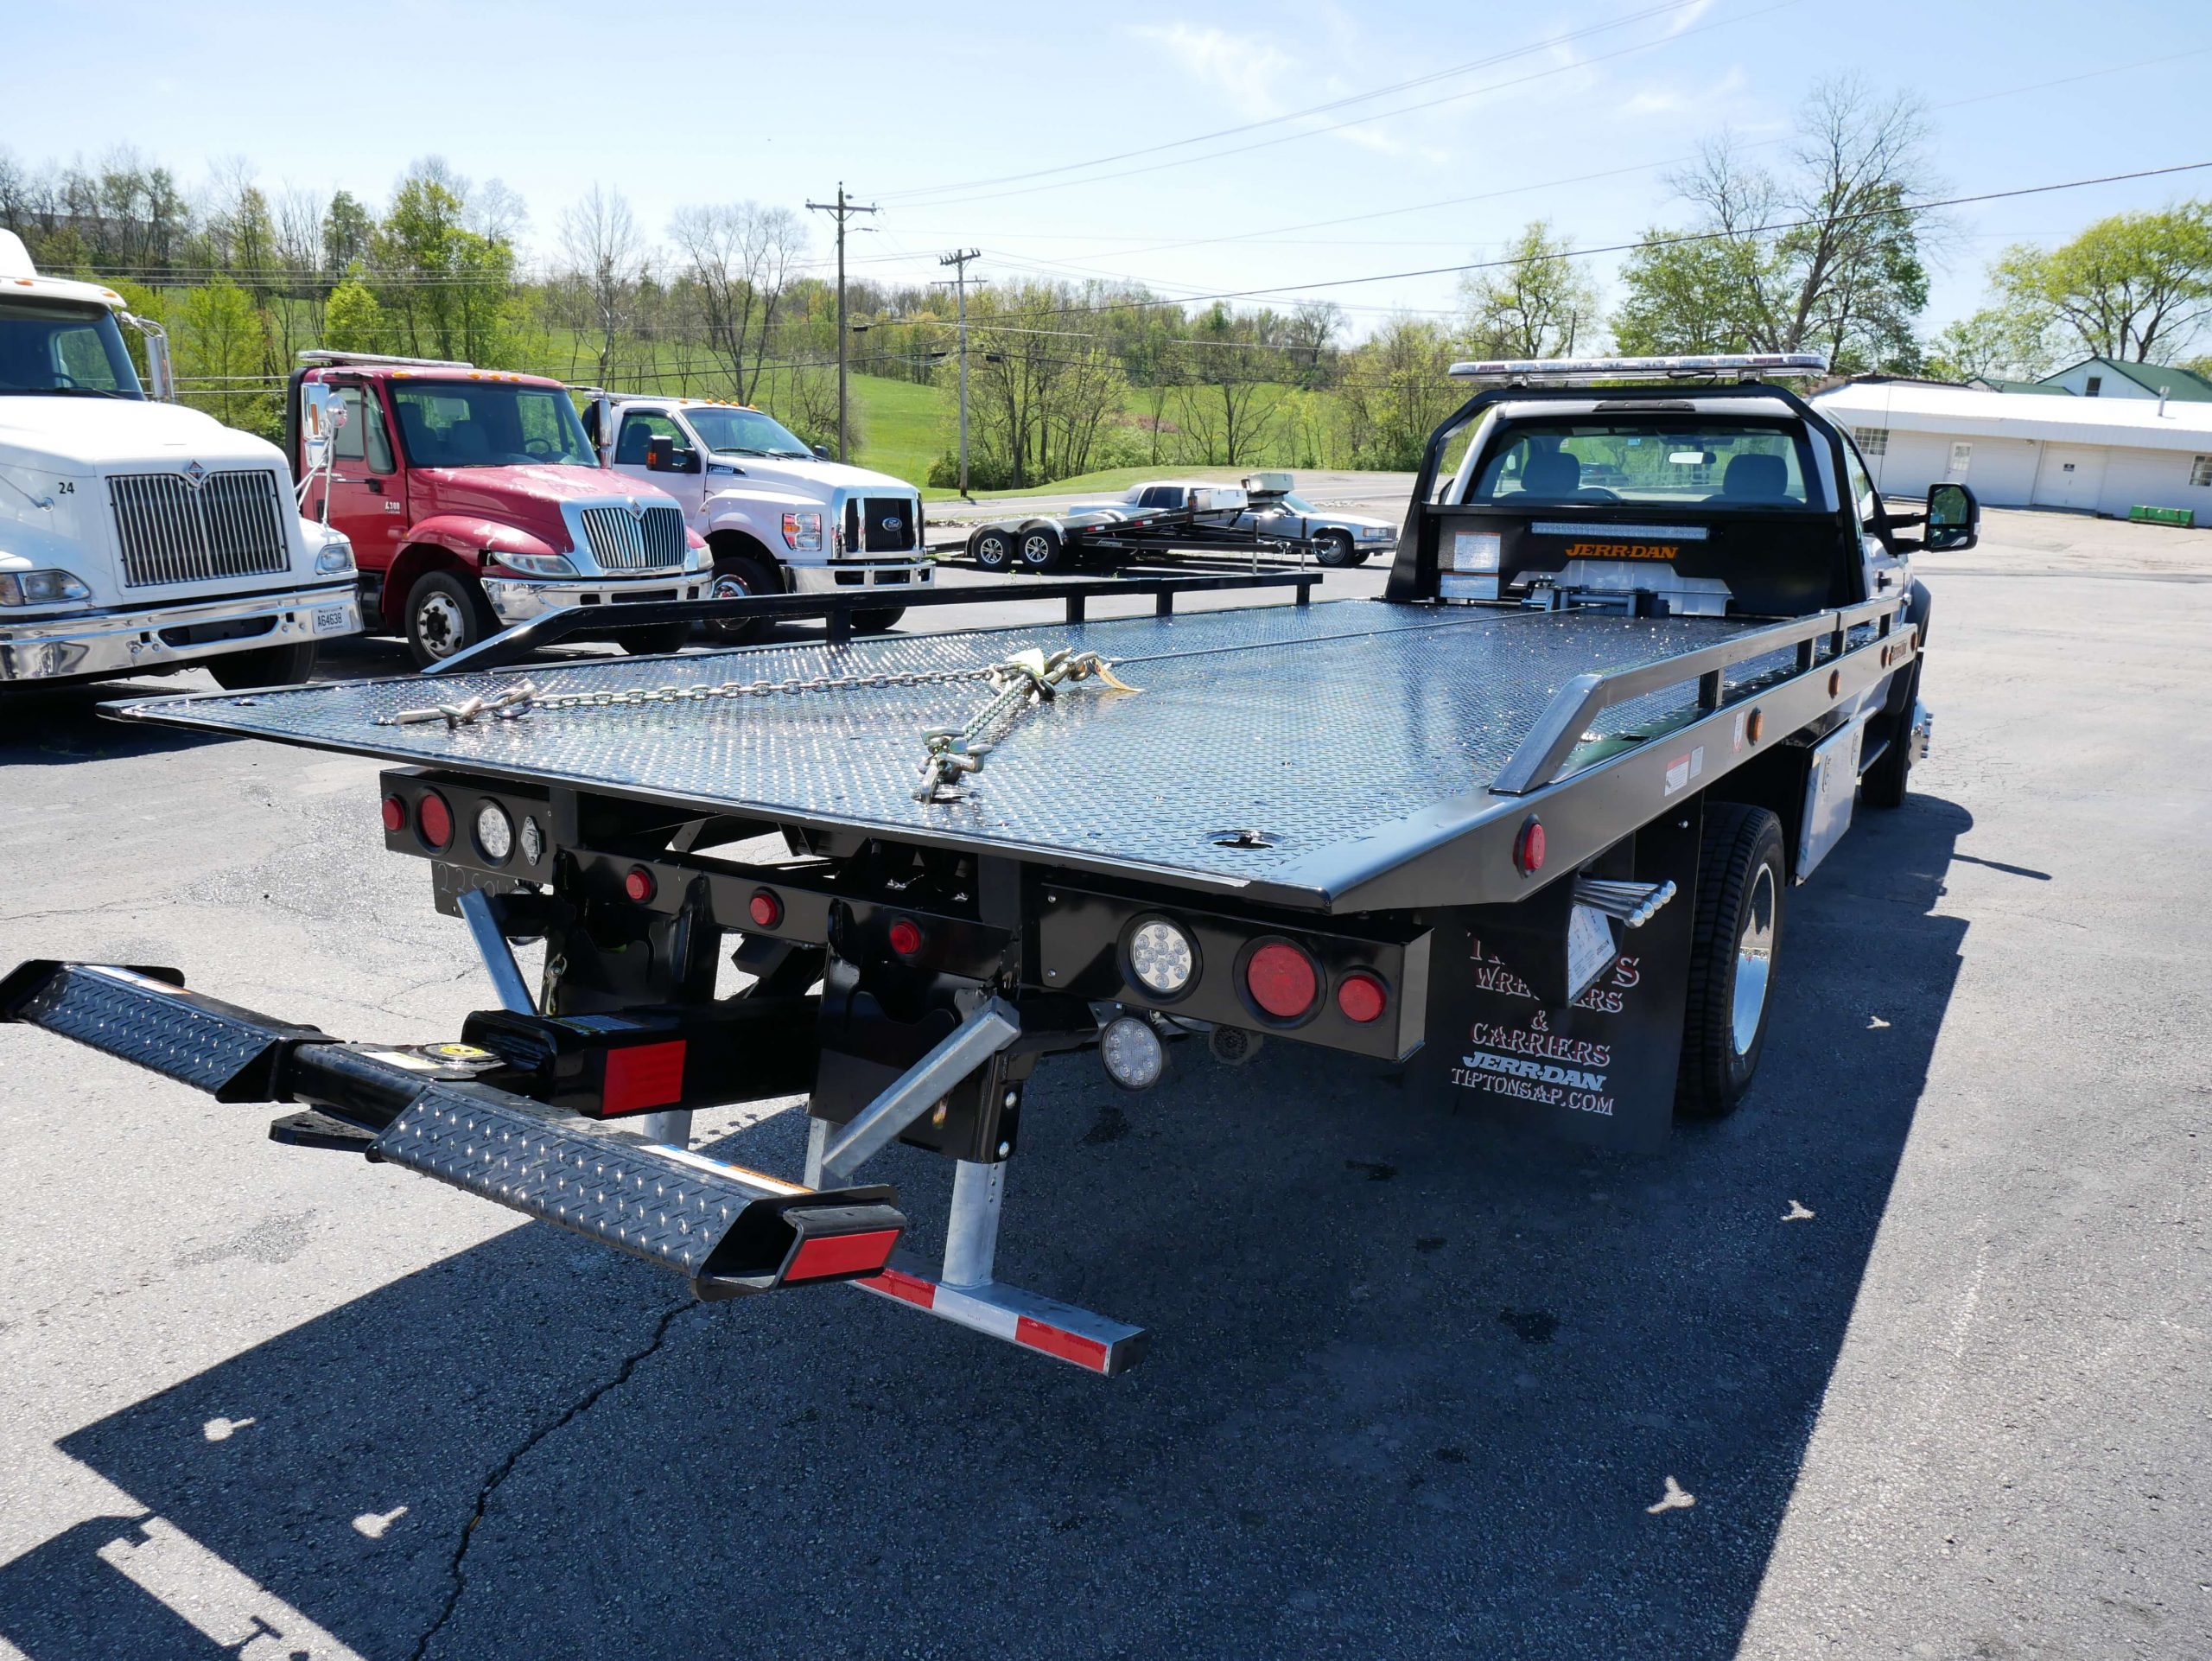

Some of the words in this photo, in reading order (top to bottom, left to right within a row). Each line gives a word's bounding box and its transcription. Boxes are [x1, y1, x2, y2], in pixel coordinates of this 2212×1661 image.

[59, 482, 75, 493] 24
[1472, 1022, 1611, 1067] CARRIERS
[1452, 1068, 1614, 1116] TIPTONSAP.COM
